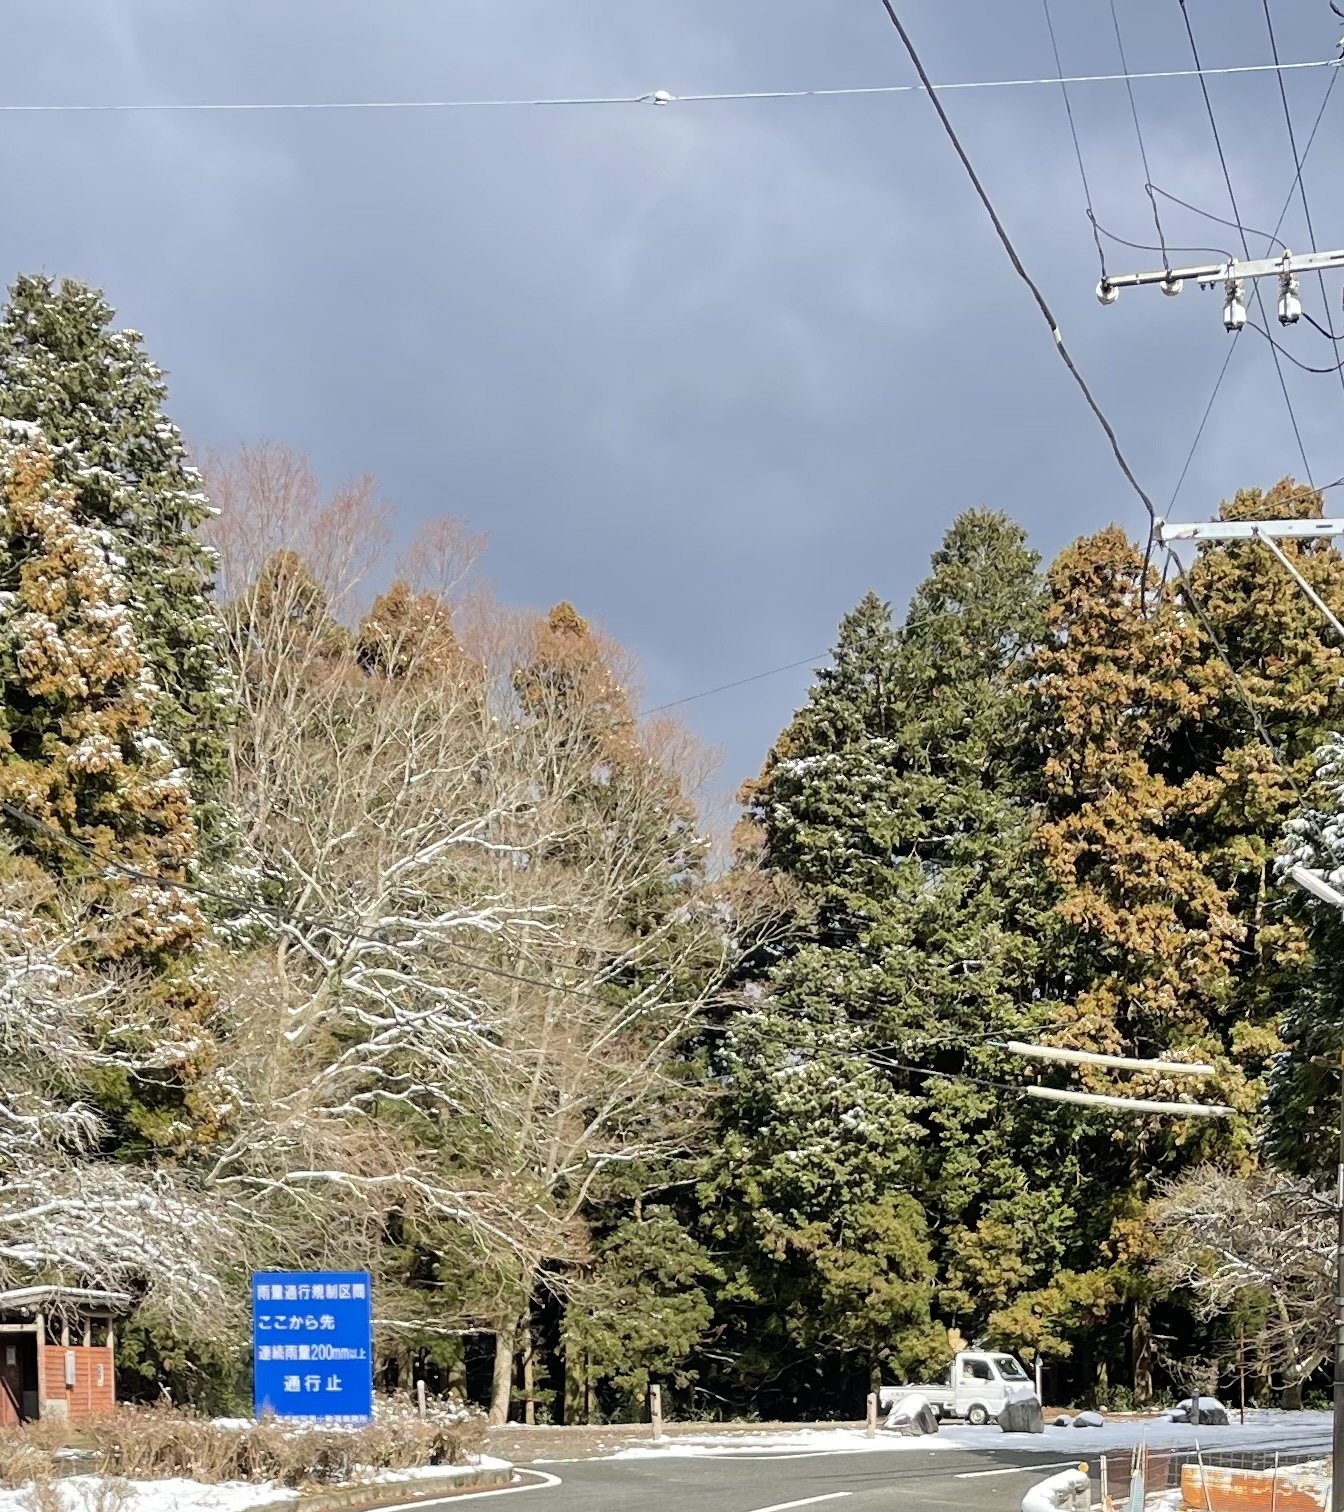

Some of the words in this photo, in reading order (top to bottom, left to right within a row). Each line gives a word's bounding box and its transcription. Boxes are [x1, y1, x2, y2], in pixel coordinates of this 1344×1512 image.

[257, 1284, 365, 1300] 雨量通行規制区間
[258, 1314, 336, 1330] ここから先
[283, 1374, 343, 1392] 通行止
